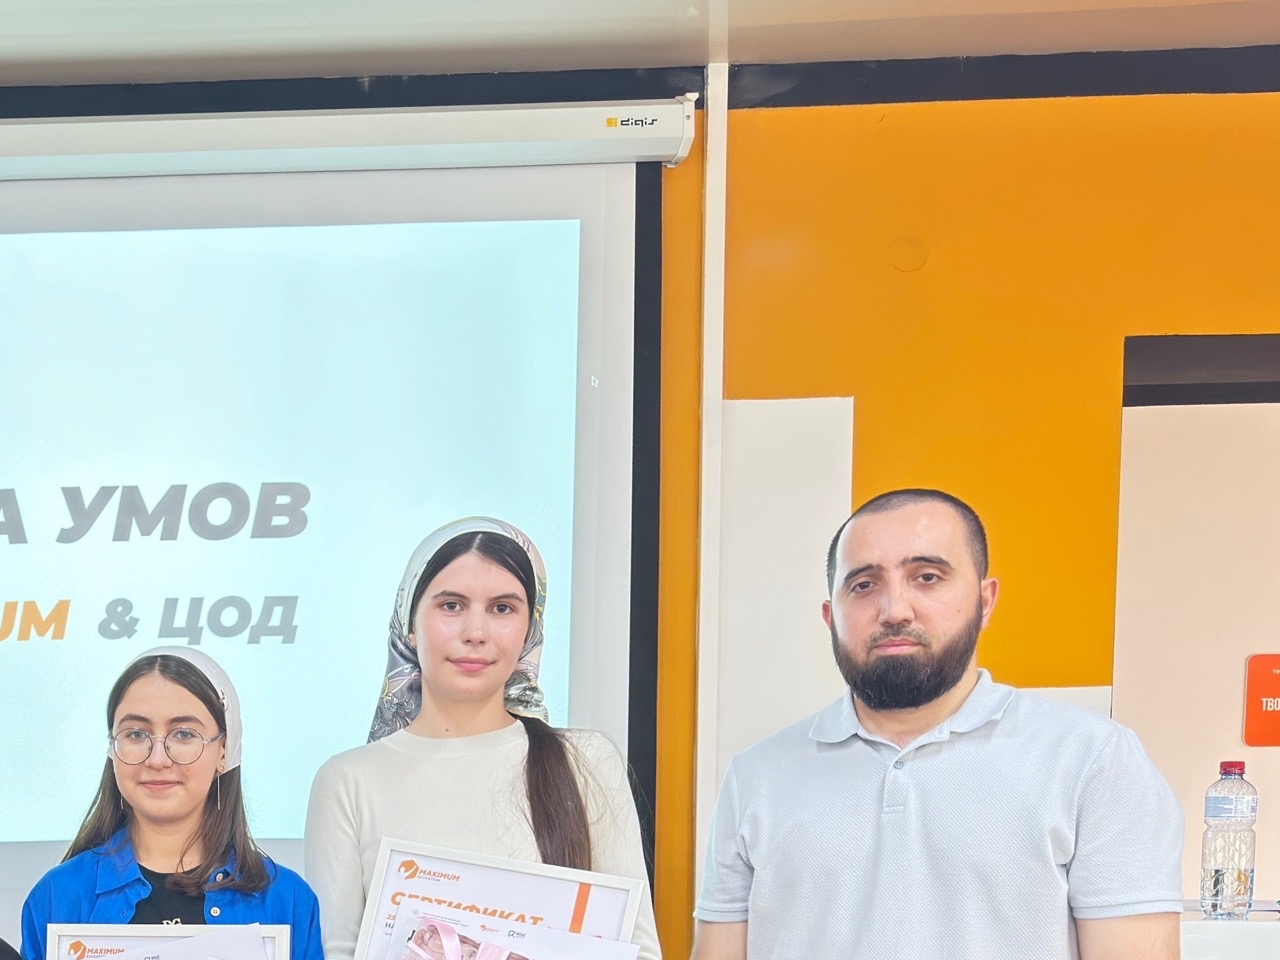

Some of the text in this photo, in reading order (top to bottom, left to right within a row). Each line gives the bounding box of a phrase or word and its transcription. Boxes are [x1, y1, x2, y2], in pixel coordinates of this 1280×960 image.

[56, 482, 312, 545] УМОВ
[96, 597, 141, 640] &
[157, 595, 300, 645] ЦОД
[419, 868, 461, 882] MAXIMUM
